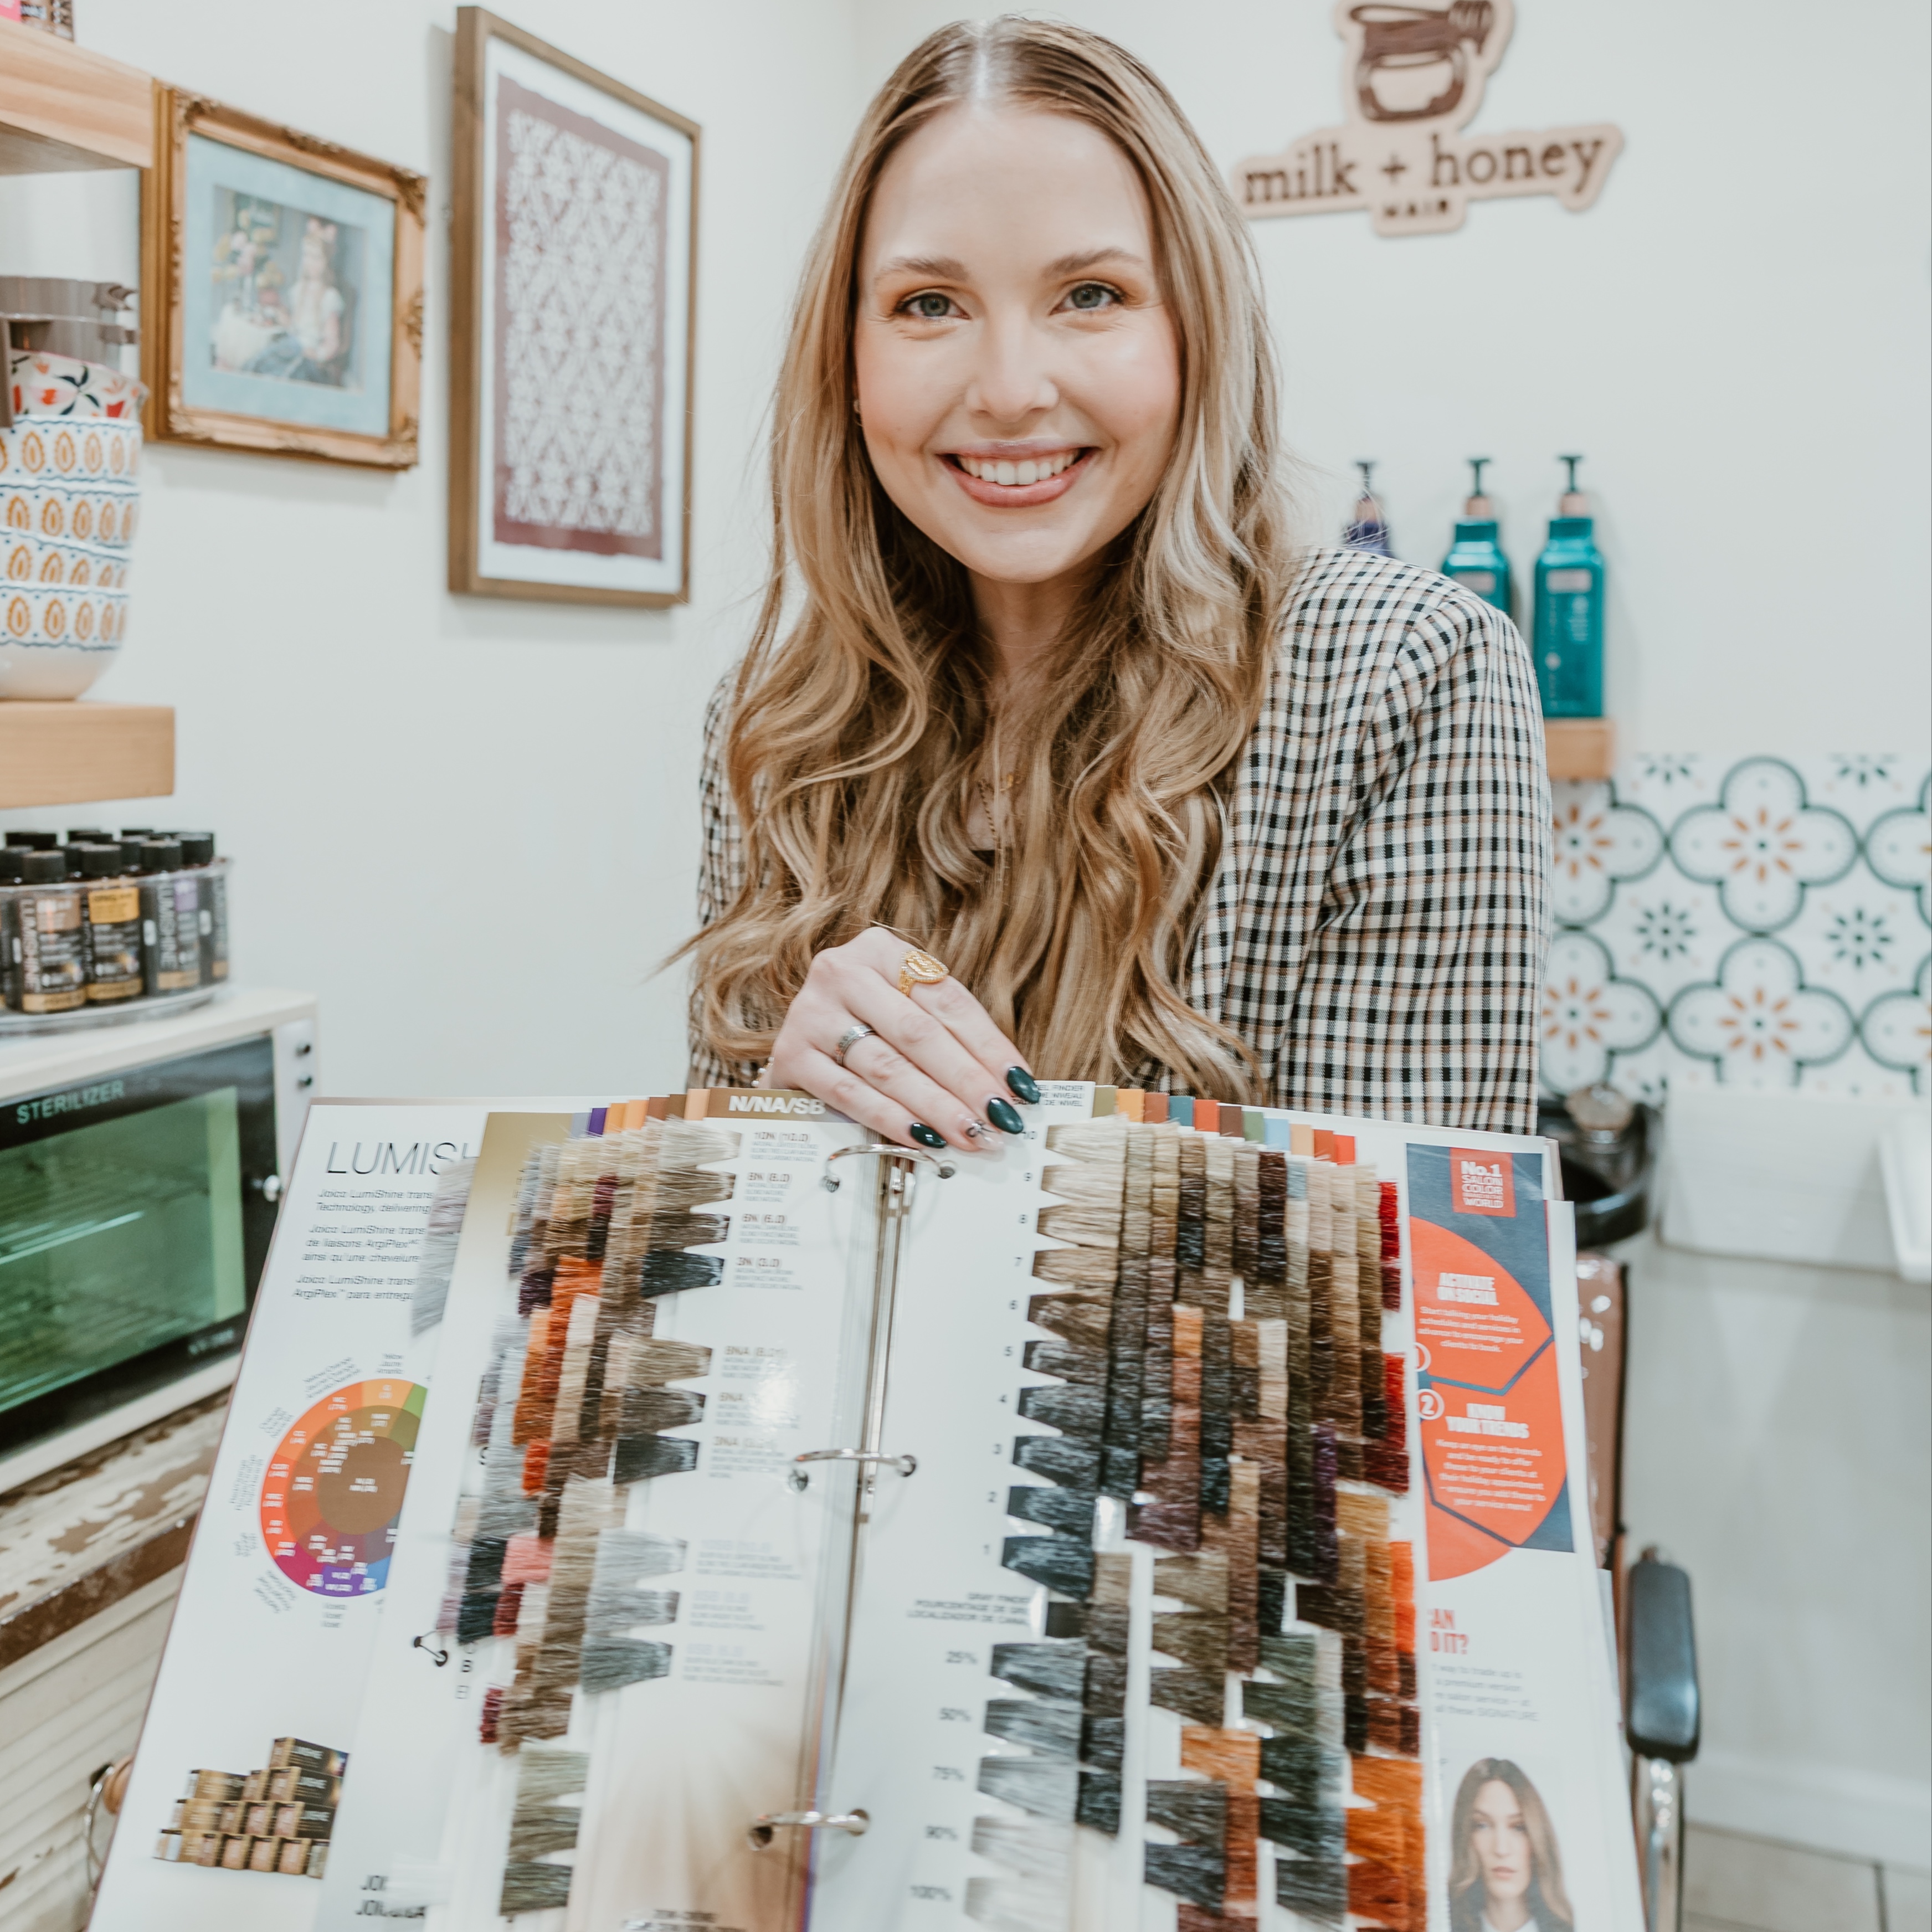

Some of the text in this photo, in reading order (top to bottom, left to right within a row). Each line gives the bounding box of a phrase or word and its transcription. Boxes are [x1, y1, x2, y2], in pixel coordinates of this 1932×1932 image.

[1244, 144, 1359, 204] milk
[1429, 135, 1604, 194] honey
[17, 1080, 125, 1124] STERILIZER
[1461, 1161, 1502, 1176] No.1
[1461, 1175, 1503, 1186] SALON
[1461, 1184, 1503, 1195] COLOR
[1463, 1198, 1504, 1209] WORLD
[1420, 1395, 1435, 1415] 2
